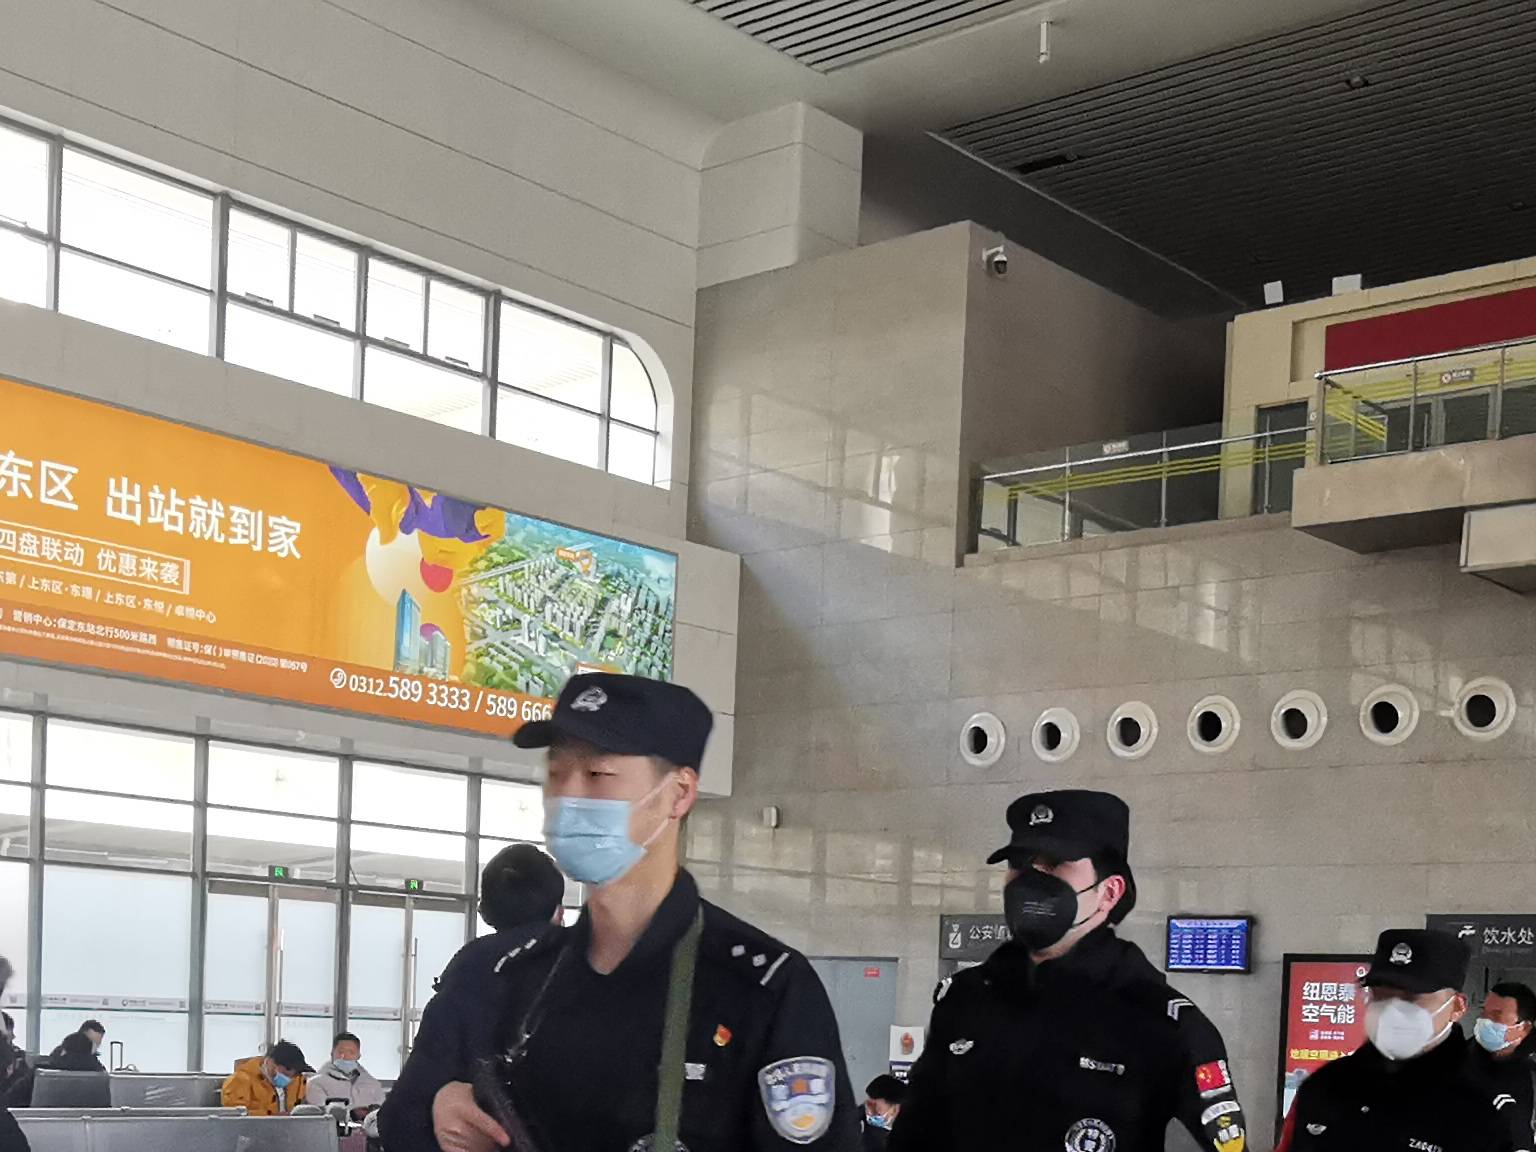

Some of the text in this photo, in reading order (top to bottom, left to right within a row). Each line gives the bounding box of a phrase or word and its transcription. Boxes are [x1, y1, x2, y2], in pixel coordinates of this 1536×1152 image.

[105, 477, 302, 559] 出站就到家
[97, 548, 180, 585] 优惠来袭
[349, 674, 423, 703] 0312.589
[426, 683, 470, 711] 3333
[485, 694, 518, 719] 589
[1483, 927, 1535, 945] 饮水处
[1302, 982, 1356, 1001] 纽恩泰
[1302, 1003, 1355, 1024] 空气能
